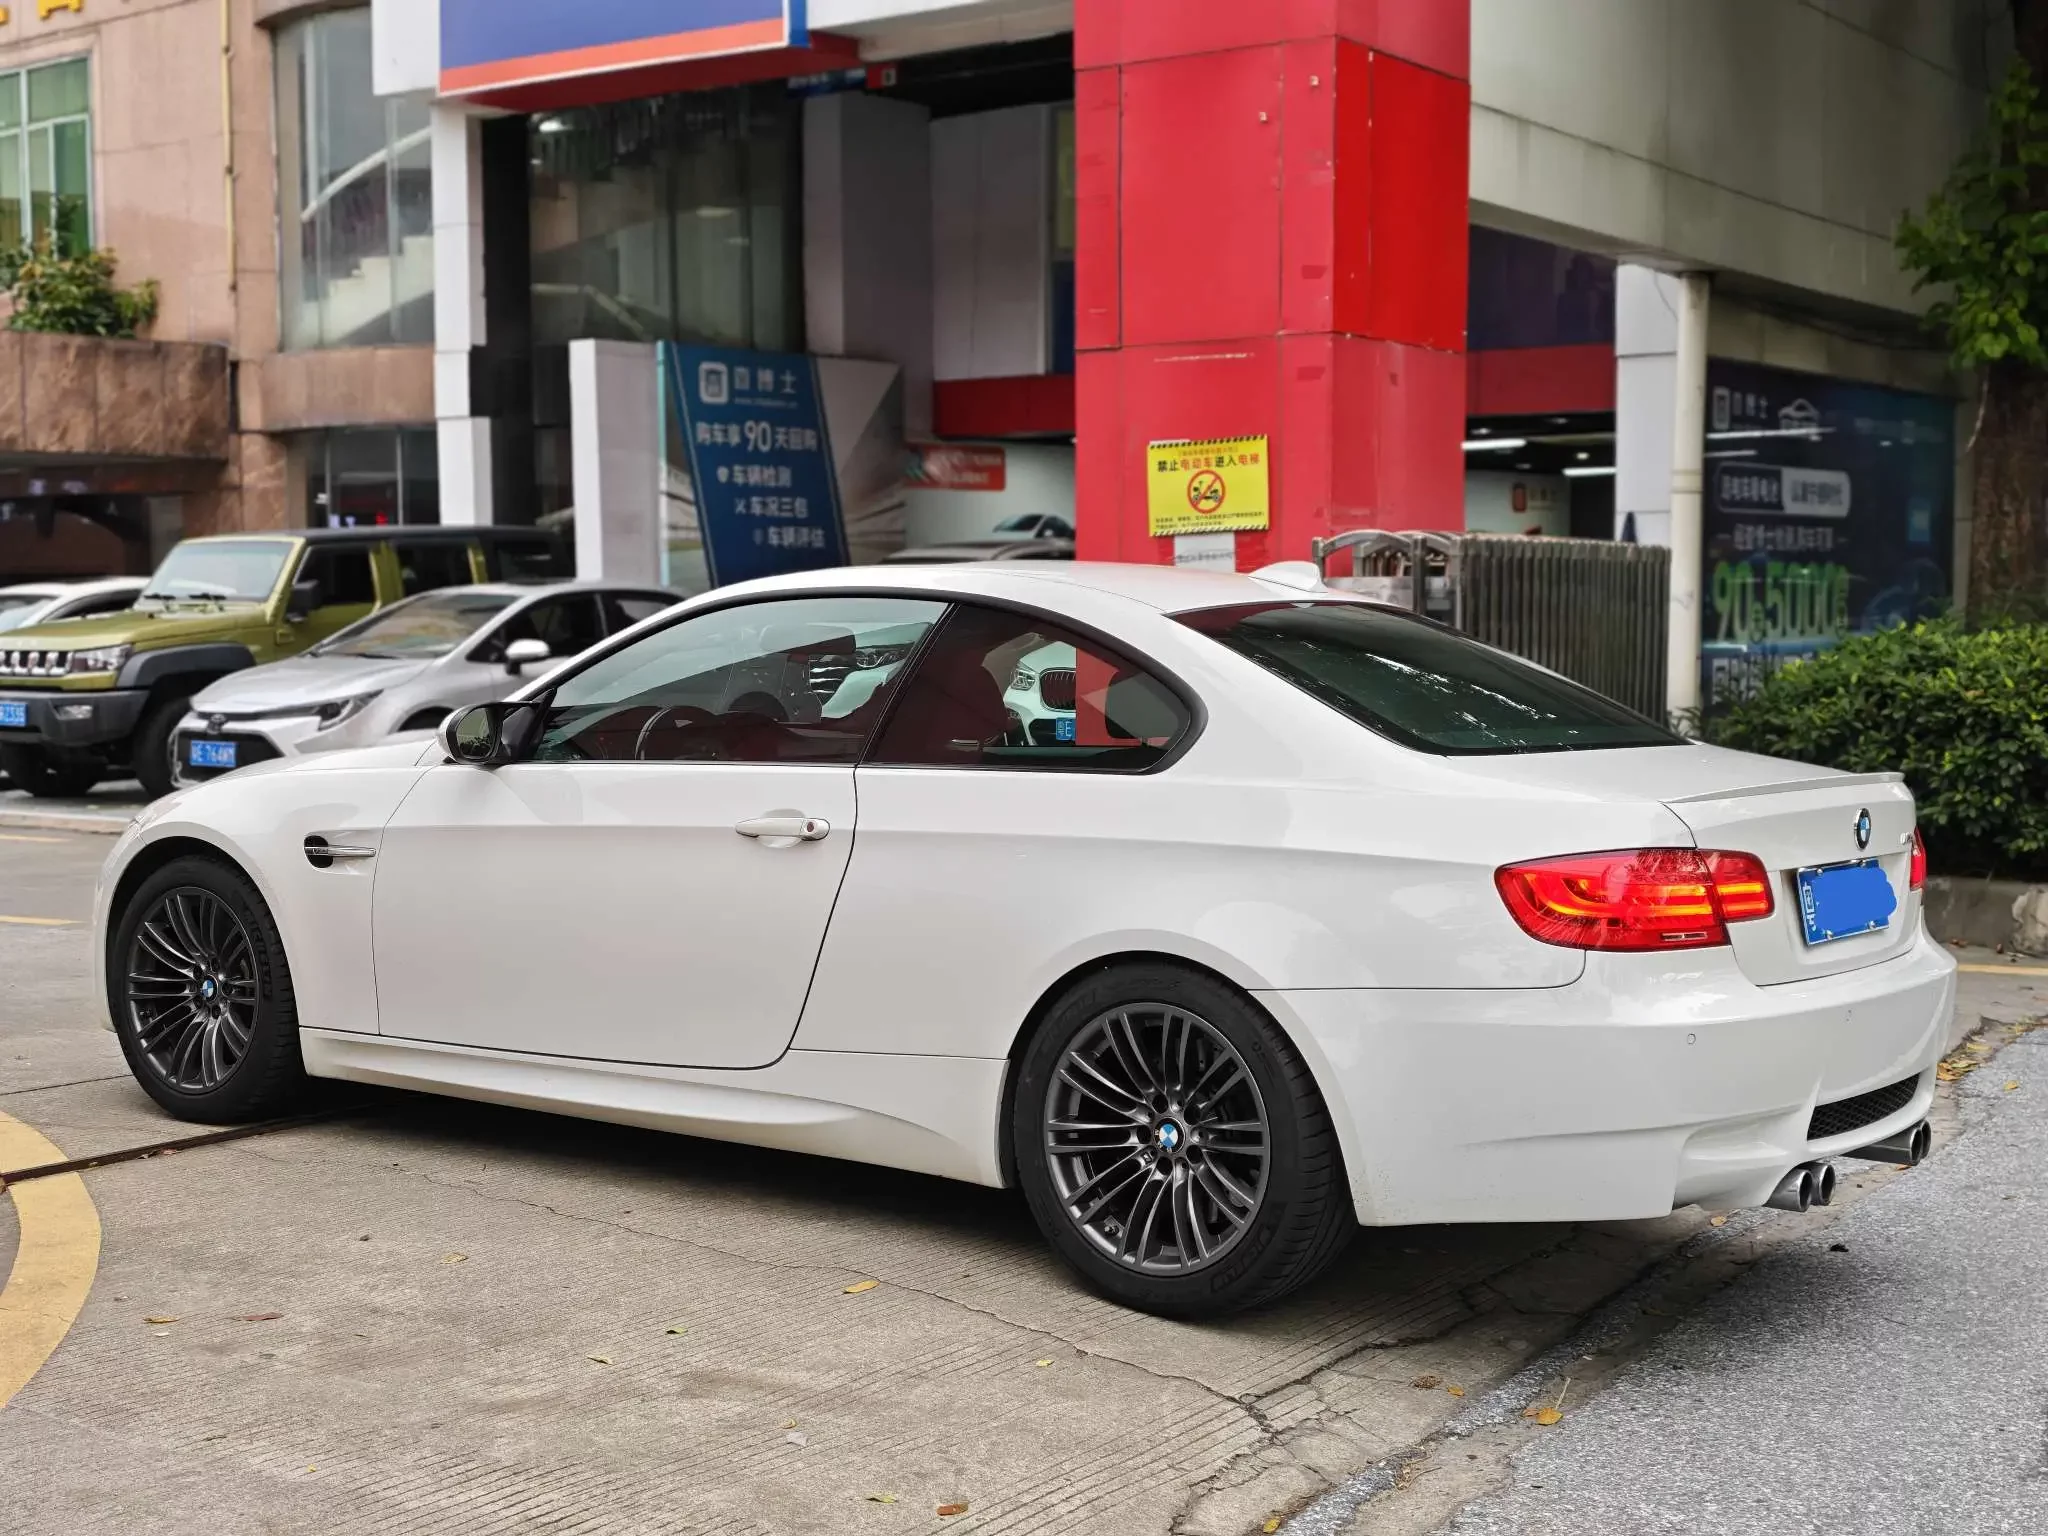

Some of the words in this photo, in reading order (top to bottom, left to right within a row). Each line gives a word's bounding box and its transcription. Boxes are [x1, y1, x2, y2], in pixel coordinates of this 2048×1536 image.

[1157, 453, 1260, 473] 禁止电动车进入电梯
[732, 465, 792, 489] 车辆检测
[749, 496, 809, 519] 车况三包
